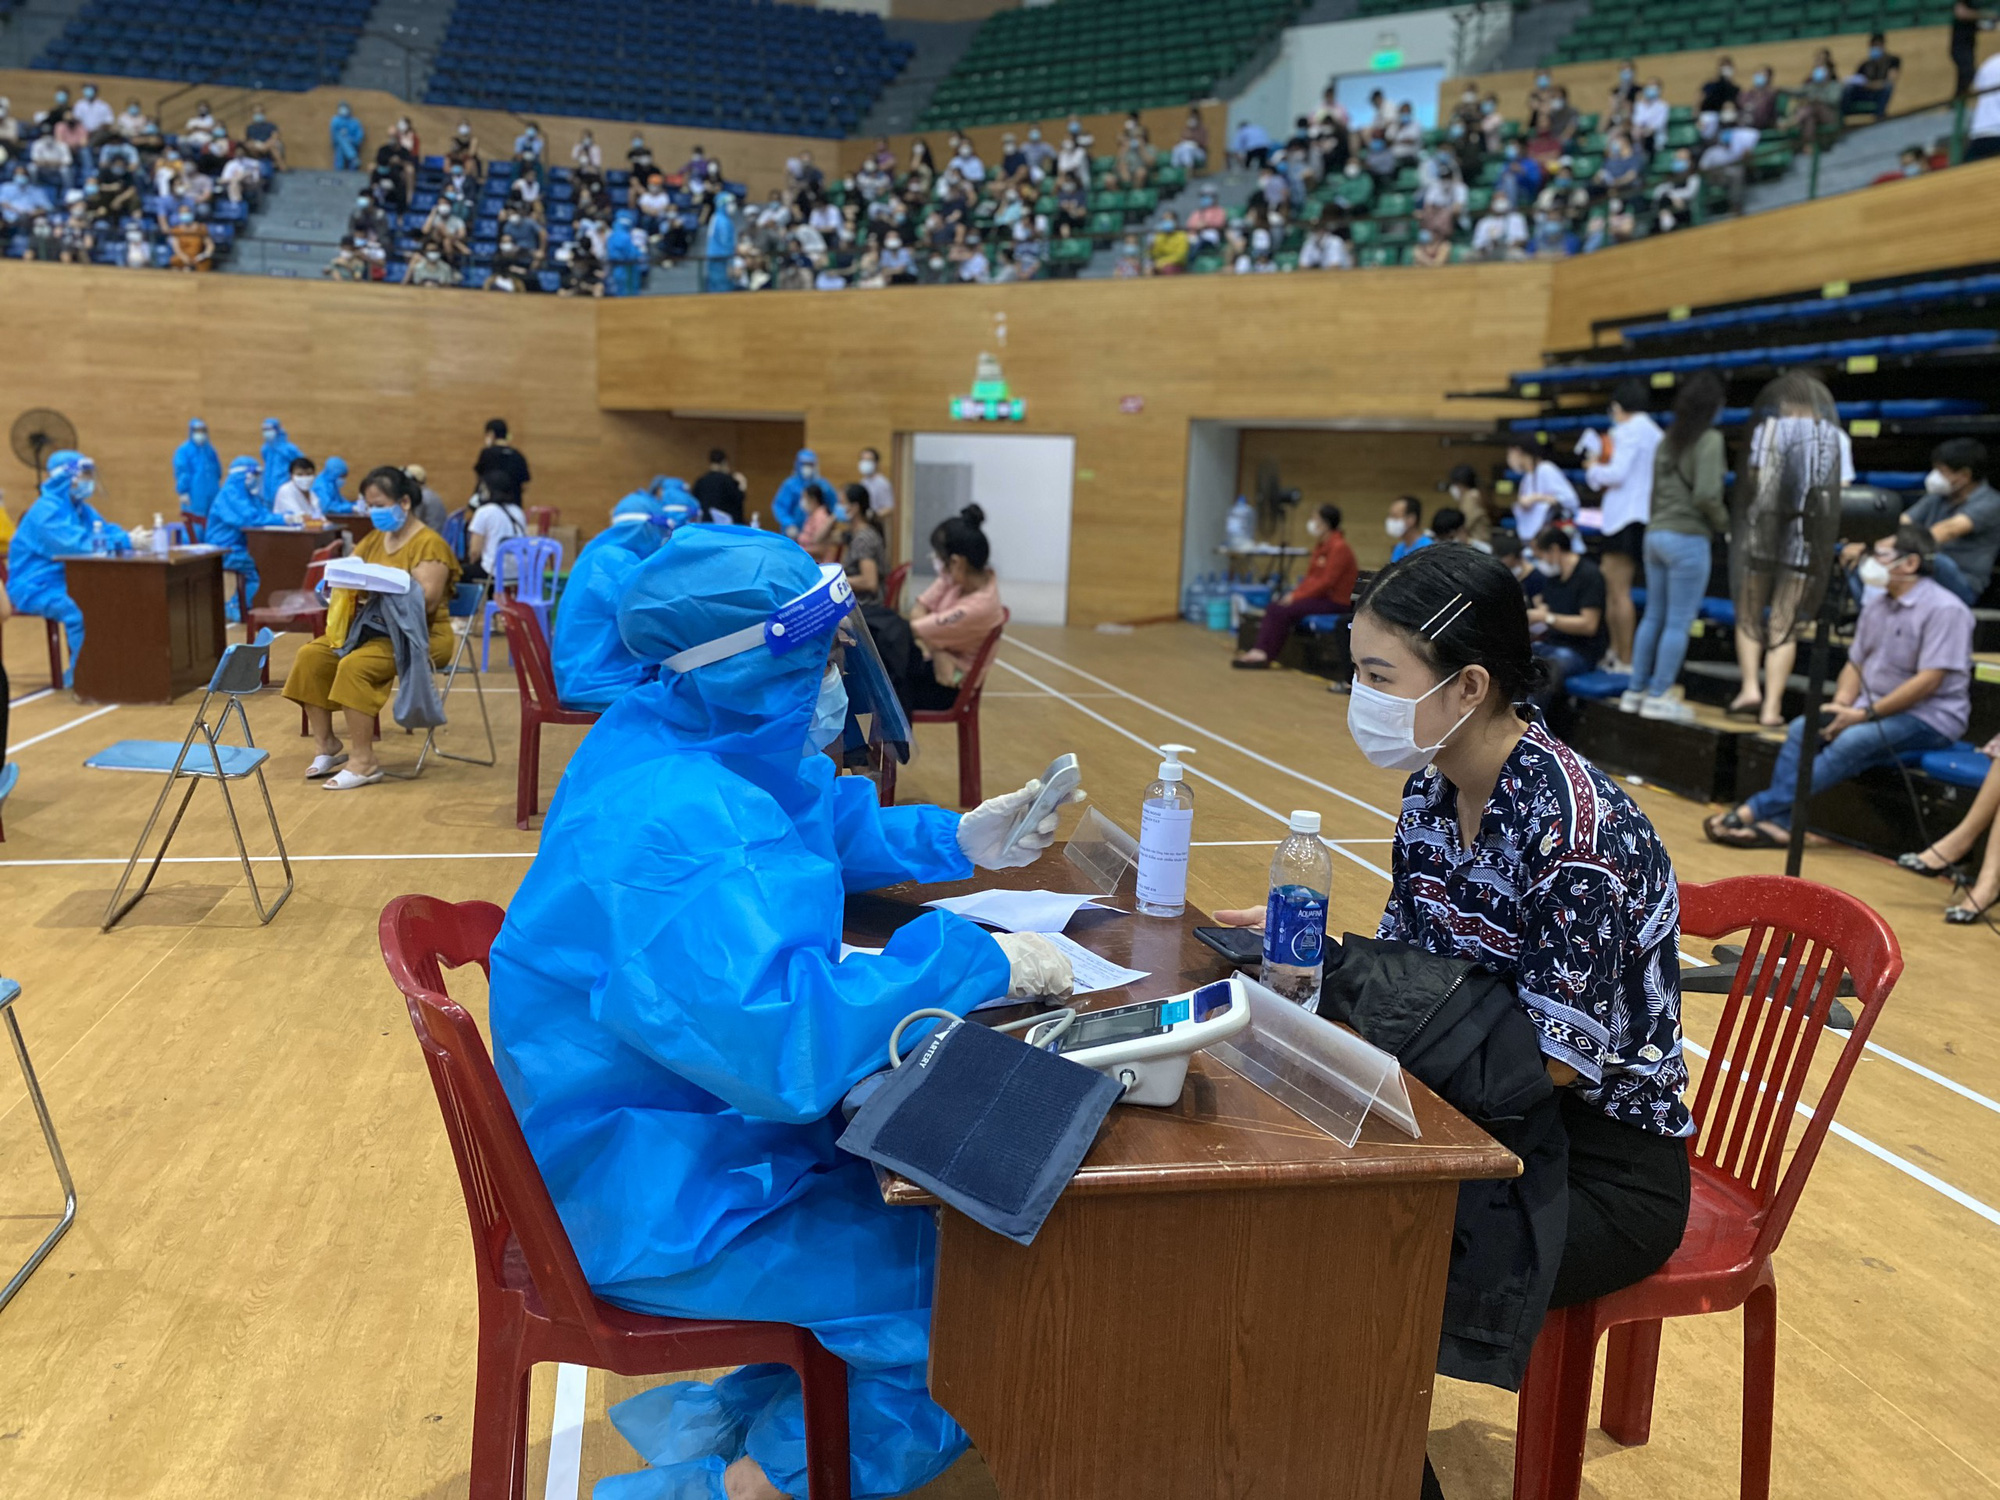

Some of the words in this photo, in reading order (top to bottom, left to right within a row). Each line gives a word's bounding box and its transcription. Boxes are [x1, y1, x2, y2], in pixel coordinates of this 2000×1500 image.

[777, 603, 805, 620] Warning
[1297, 909, 1323, 918] AQUAFINA
[919, 1040, 940, 1069] ARTERY
